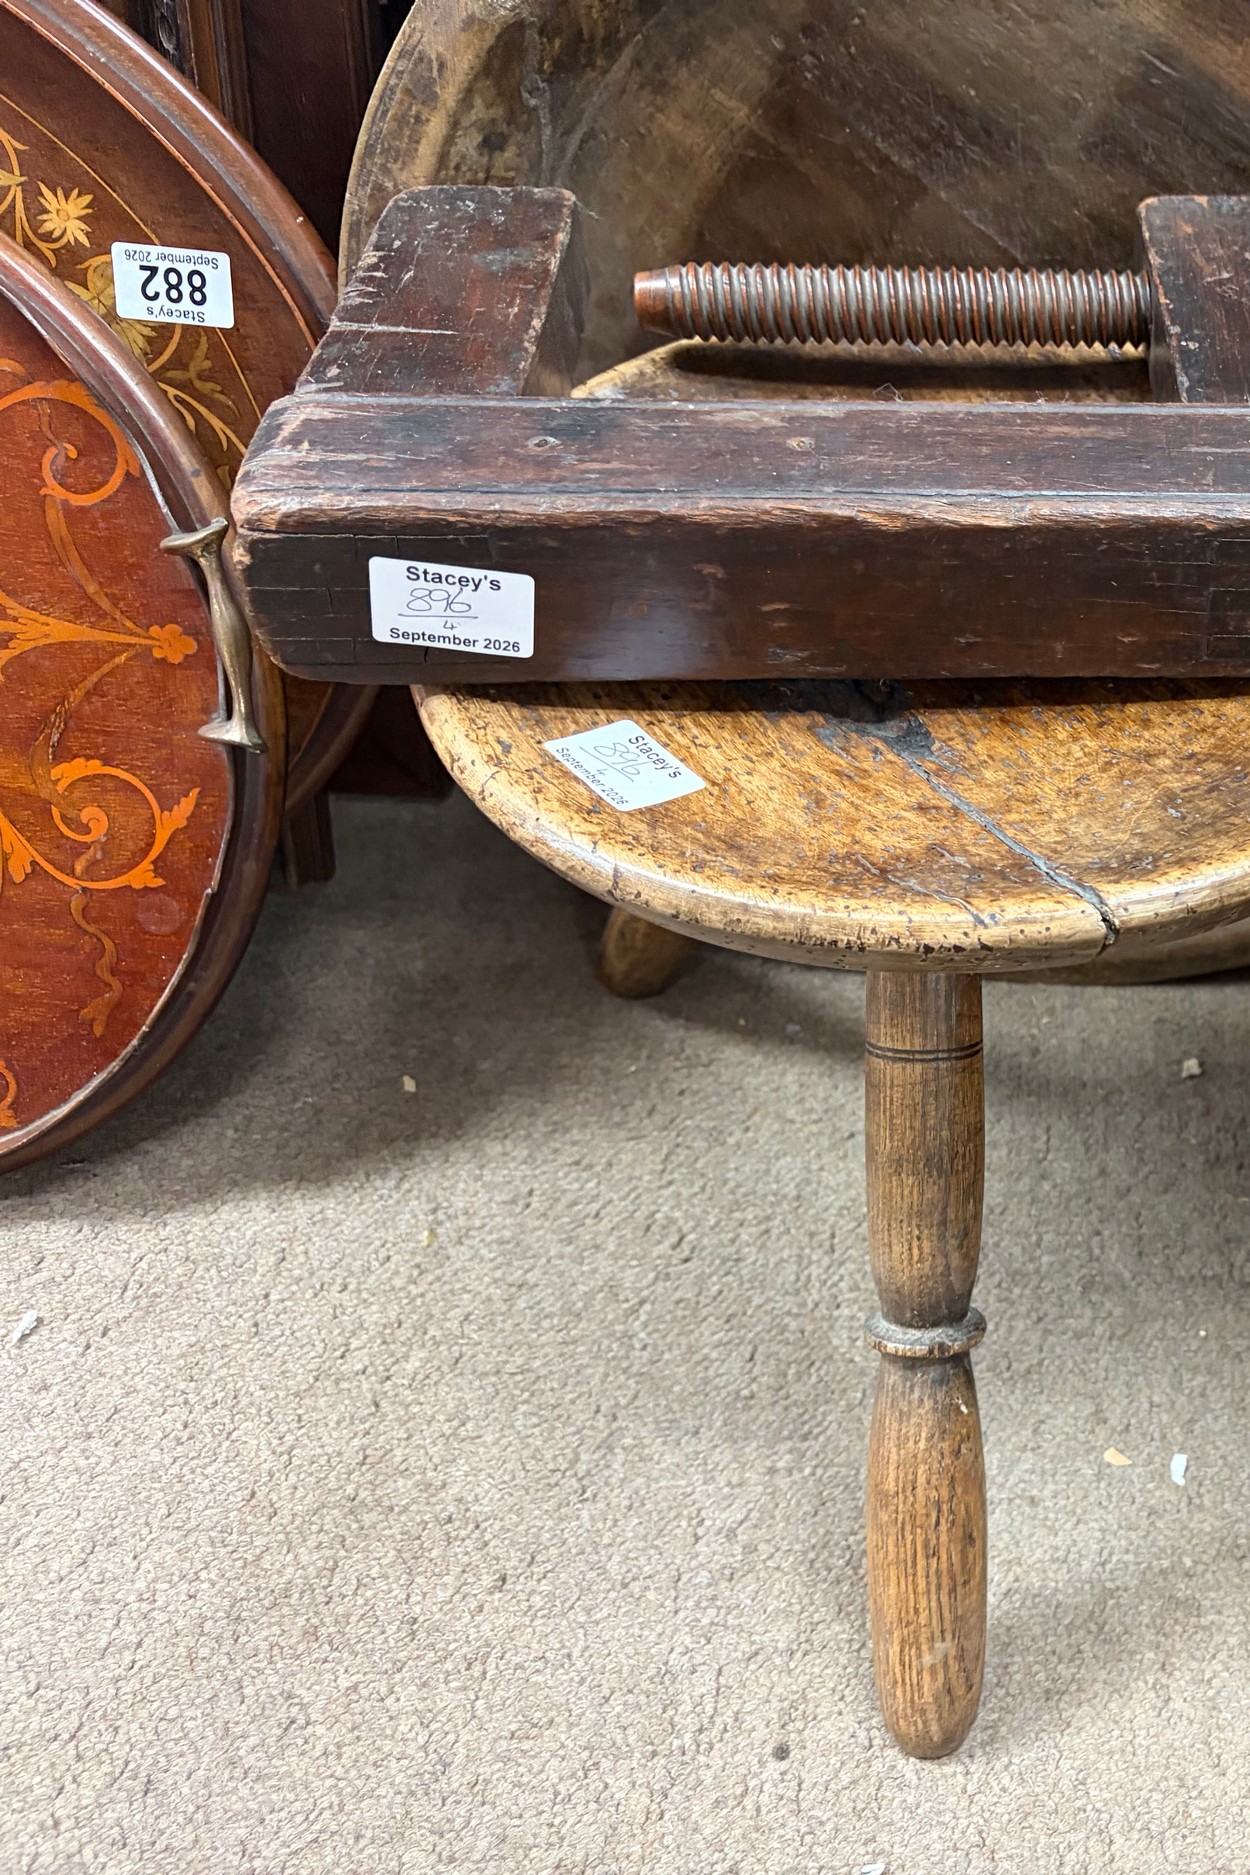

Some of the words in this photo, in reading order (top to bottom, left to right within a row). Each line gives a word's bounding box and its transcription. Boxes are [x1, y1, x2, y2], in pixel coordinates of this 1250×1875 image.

[124, 249, 151, 262] 2026
[155, 252, 218, 269] September
[139, 264, 207, 306] 882
[147, 305, 205, 322] Stacey's
[406, 565, 501, 592] Stacey's
[406, 587, 472, 613] 896
[389, 627, 479, 648] September
[483, 638, 521, 653] 2026
[593, 742, 655, 776] 896
[628, 735, 682, 779] Stacey's
[556, 747, 605, 787] September
[601, 787, 628, 805] 2026
